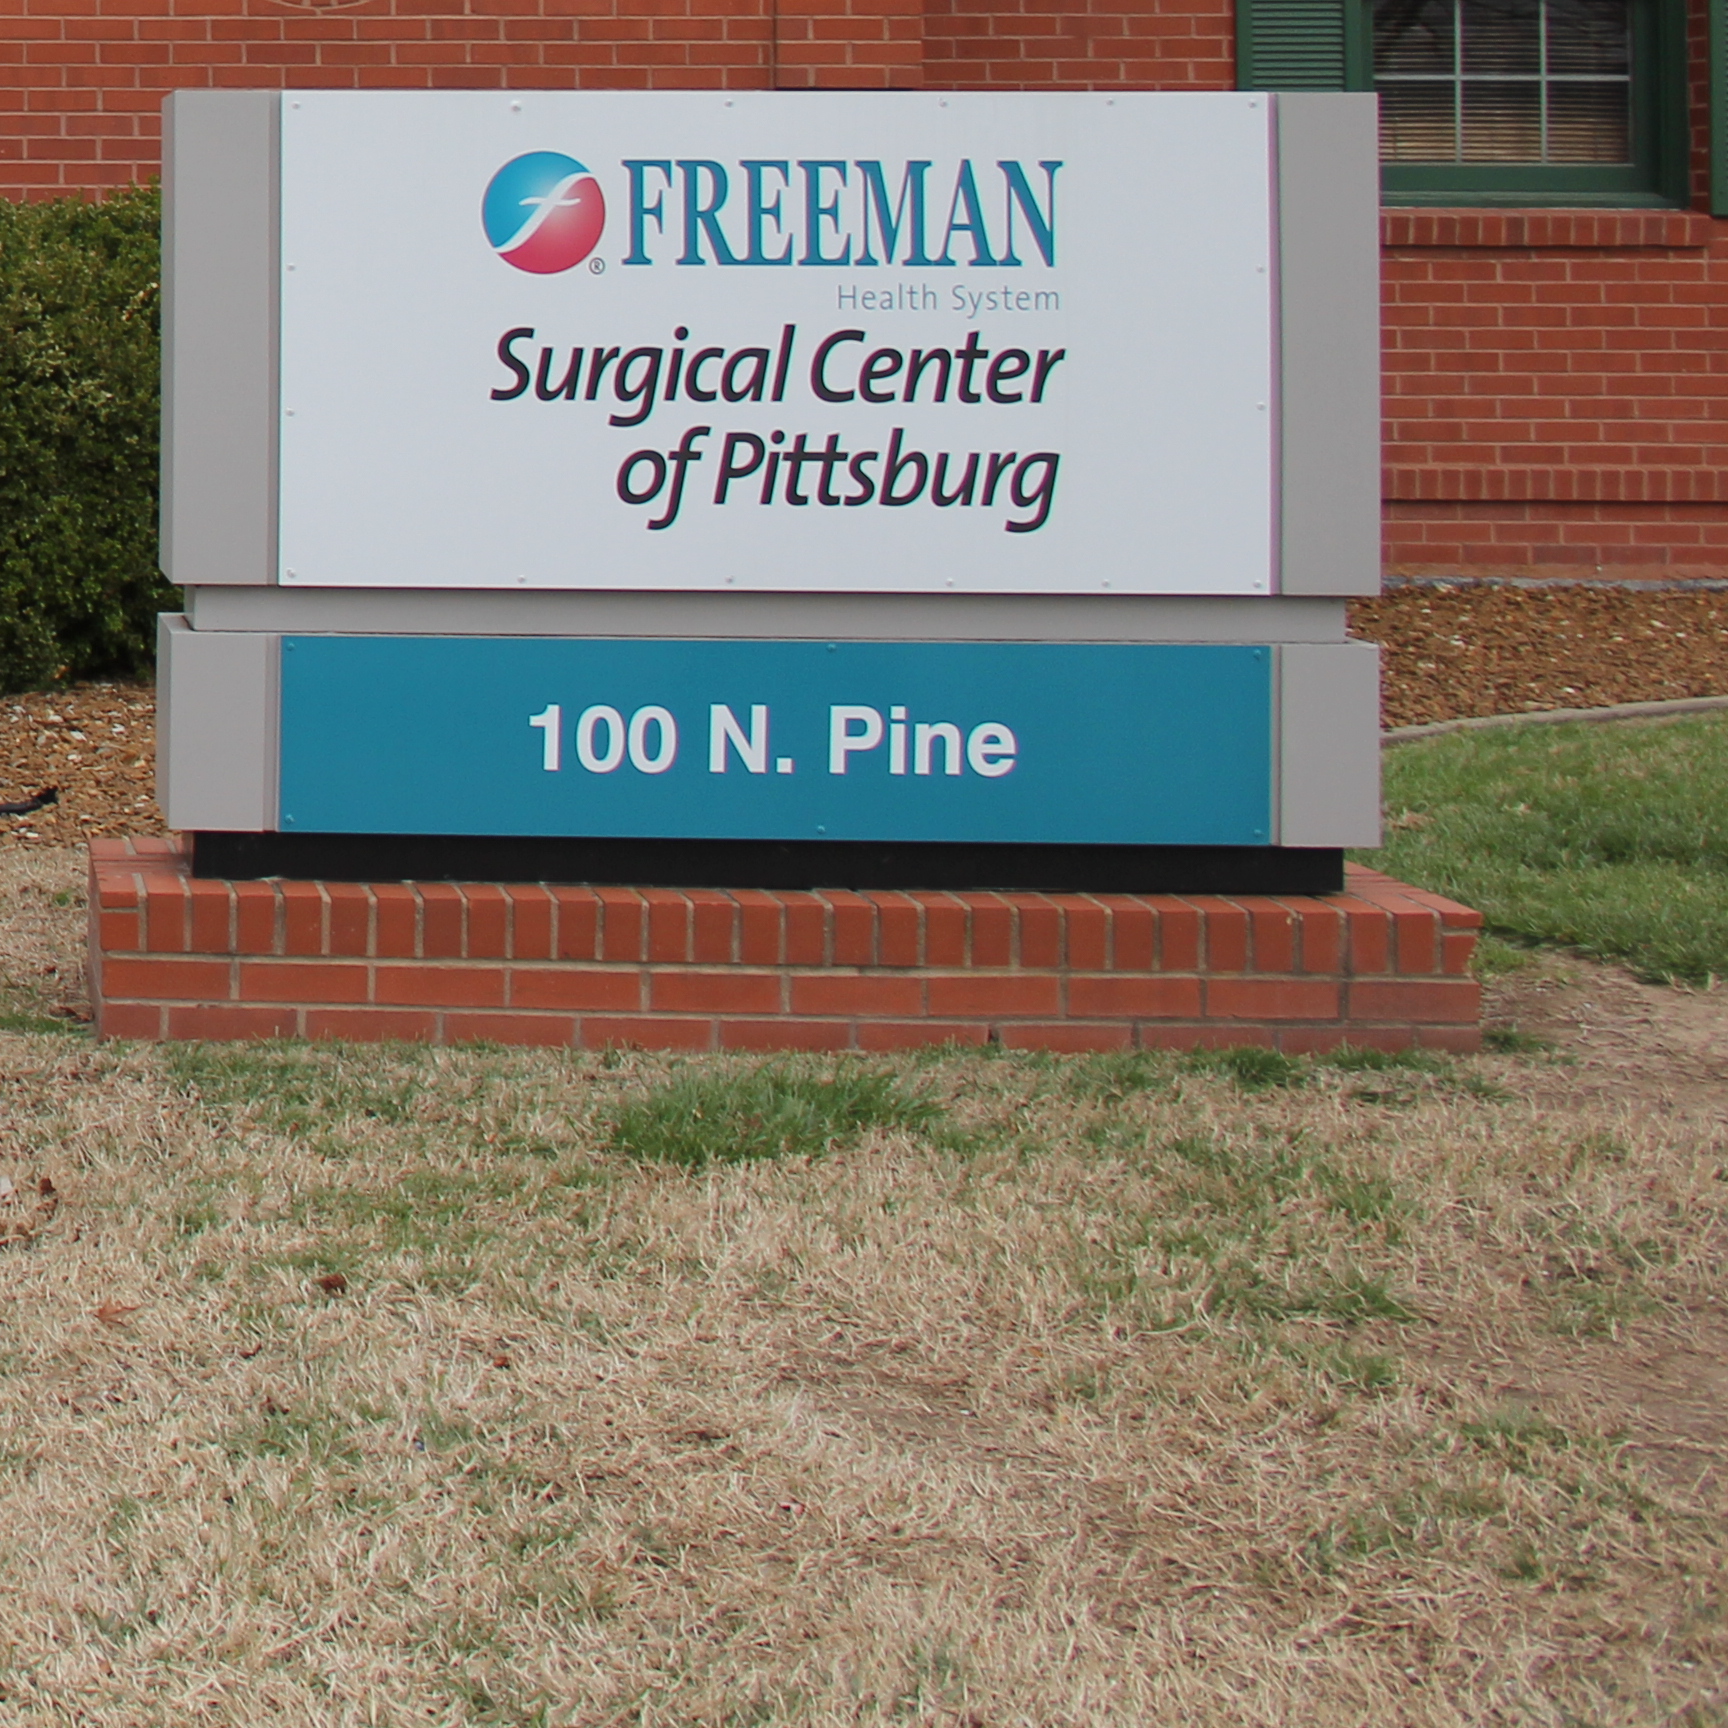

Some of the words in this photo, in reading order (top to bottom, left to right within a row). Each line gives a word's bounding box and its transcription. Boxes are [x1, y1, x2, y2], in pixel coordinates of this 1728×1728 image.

[620, 158, 1064, 268] FREEMAN
[837, 284, 939, 311] Health
[951, 284, 1061, 319] System
[489, 323, 797, 427] Surgical
[808, 329, 1067, 405] Center
[614, 425, 712, 531] of
[712, 427, 1062, 534] Pittsburg
[528, 704, 677, 774] 100
[708, 704, 794, 774] N.
[827, 705, 1018, 778] Pine
